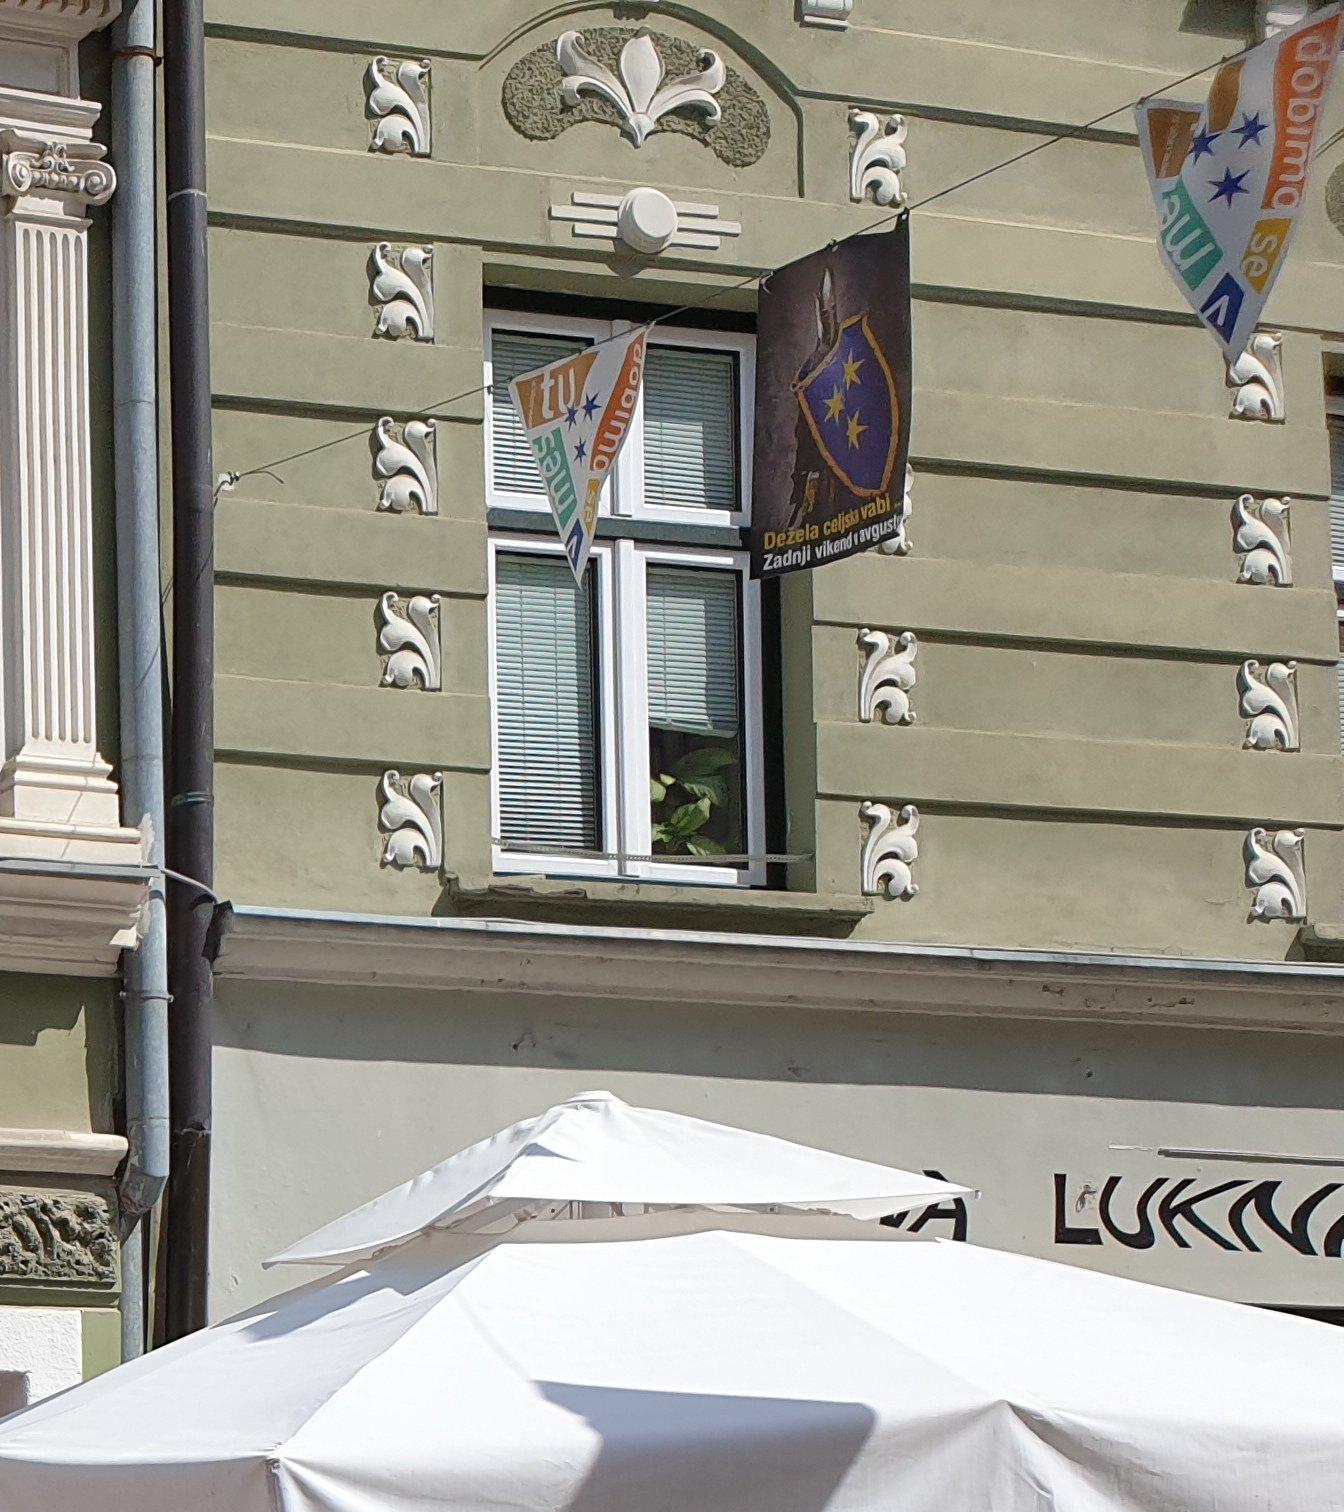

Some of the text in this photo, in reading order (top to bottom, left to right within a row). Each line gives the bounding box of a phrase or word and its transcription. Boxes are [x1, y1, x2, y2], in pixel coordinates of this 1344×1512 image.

[1241, 231, 1279, 278] se
[861, 493, 891, 519] vabi
[763, 546, 812, 571] Zadnji
[815, 535, 853, 560] vikend
